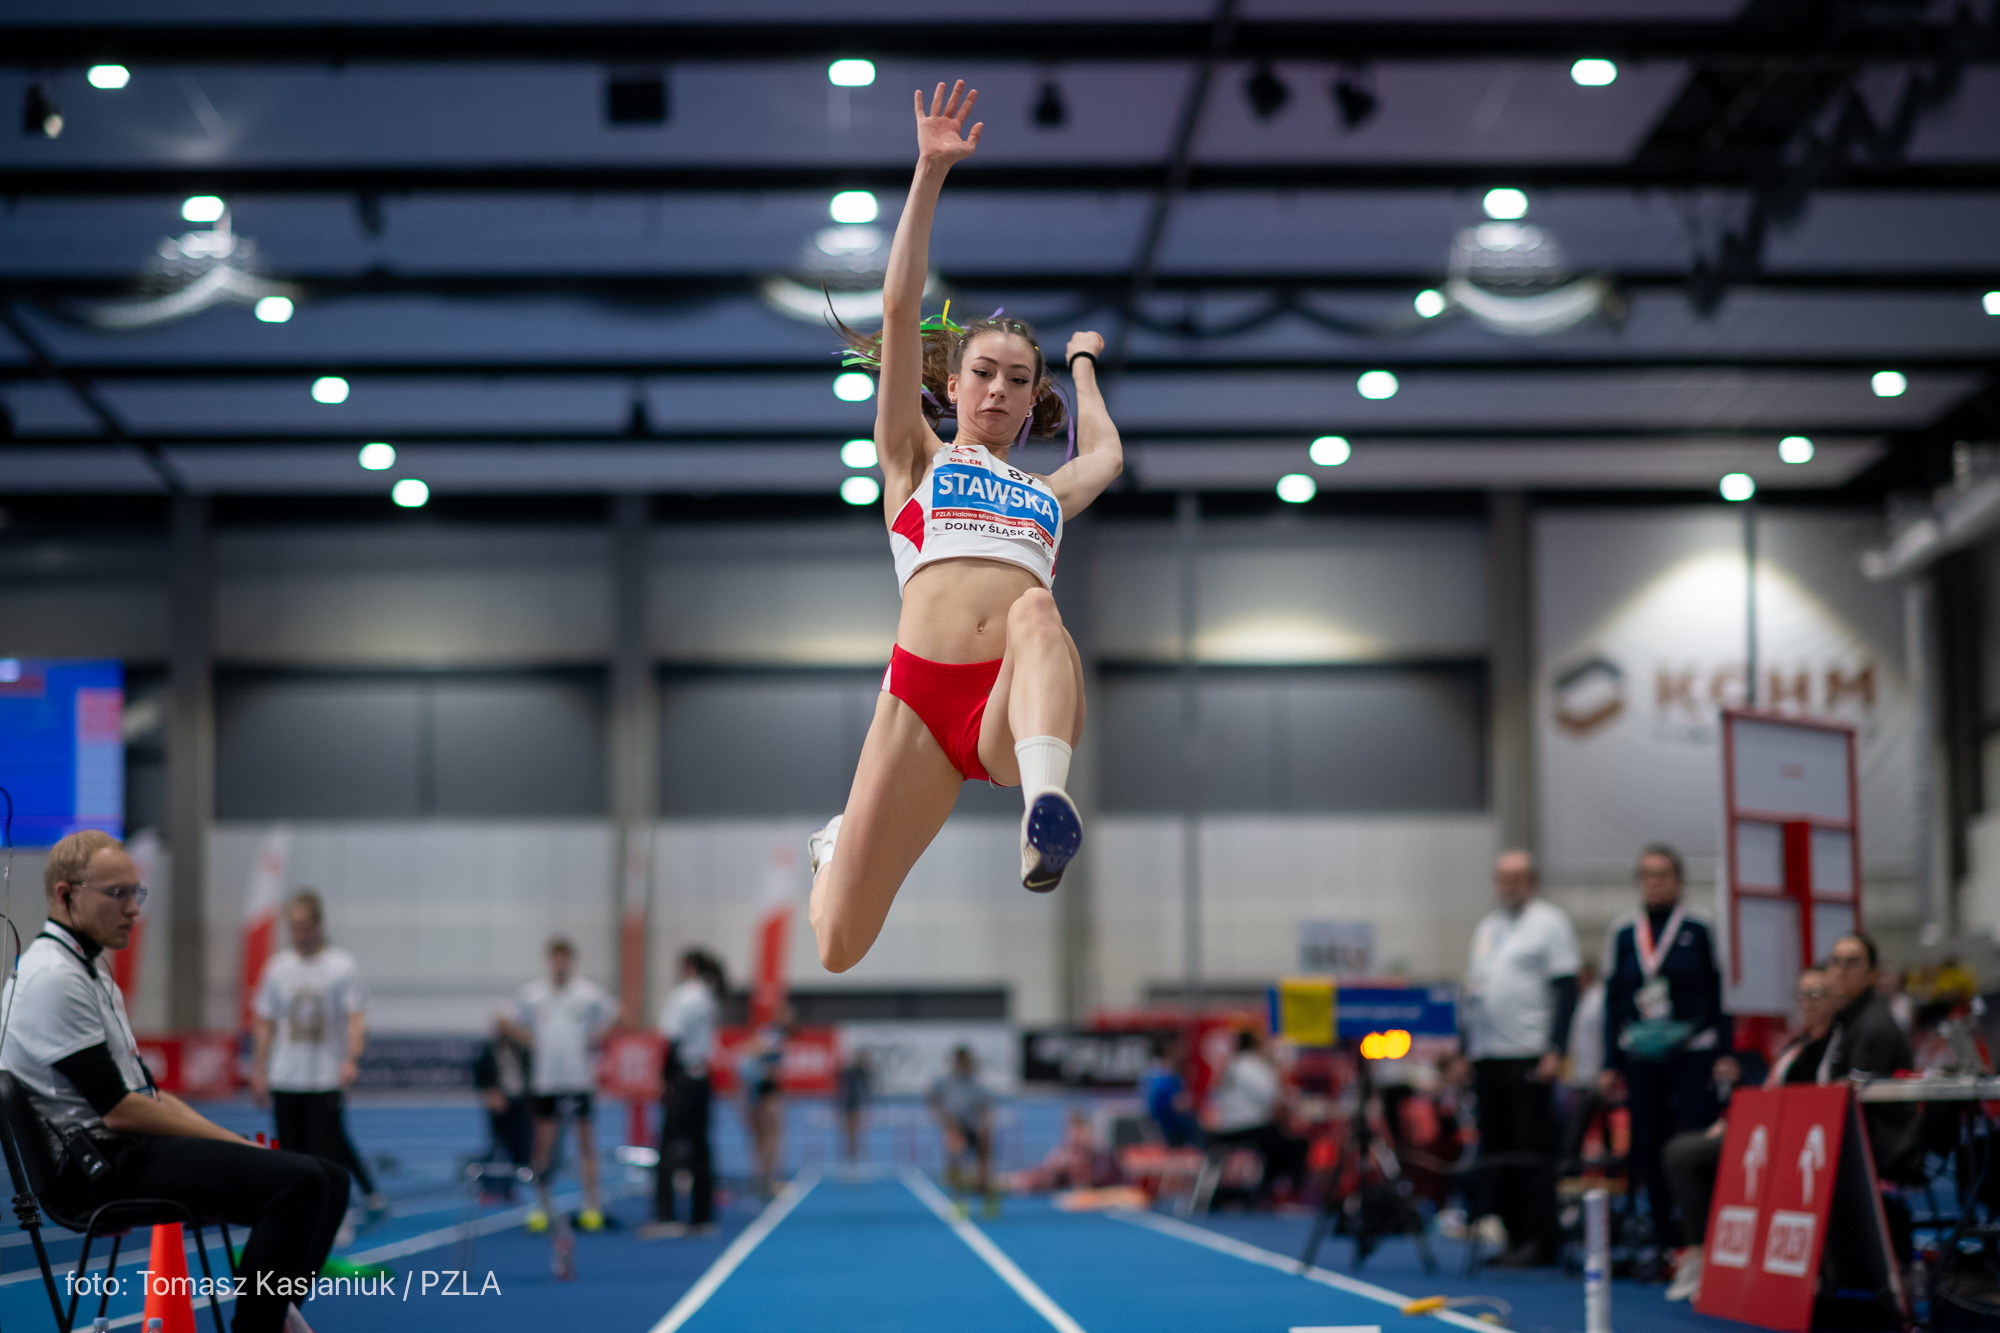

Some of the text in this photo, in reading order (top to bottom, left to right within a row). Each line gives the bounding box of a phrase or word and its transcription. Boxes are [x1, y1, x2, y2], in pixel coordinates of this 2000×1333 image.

[938, 472, 1055, 524] STAWSKA
[945, 522, 986, 532] DOLNY
[988, 523, 1025, 537] ŚLĄSK
